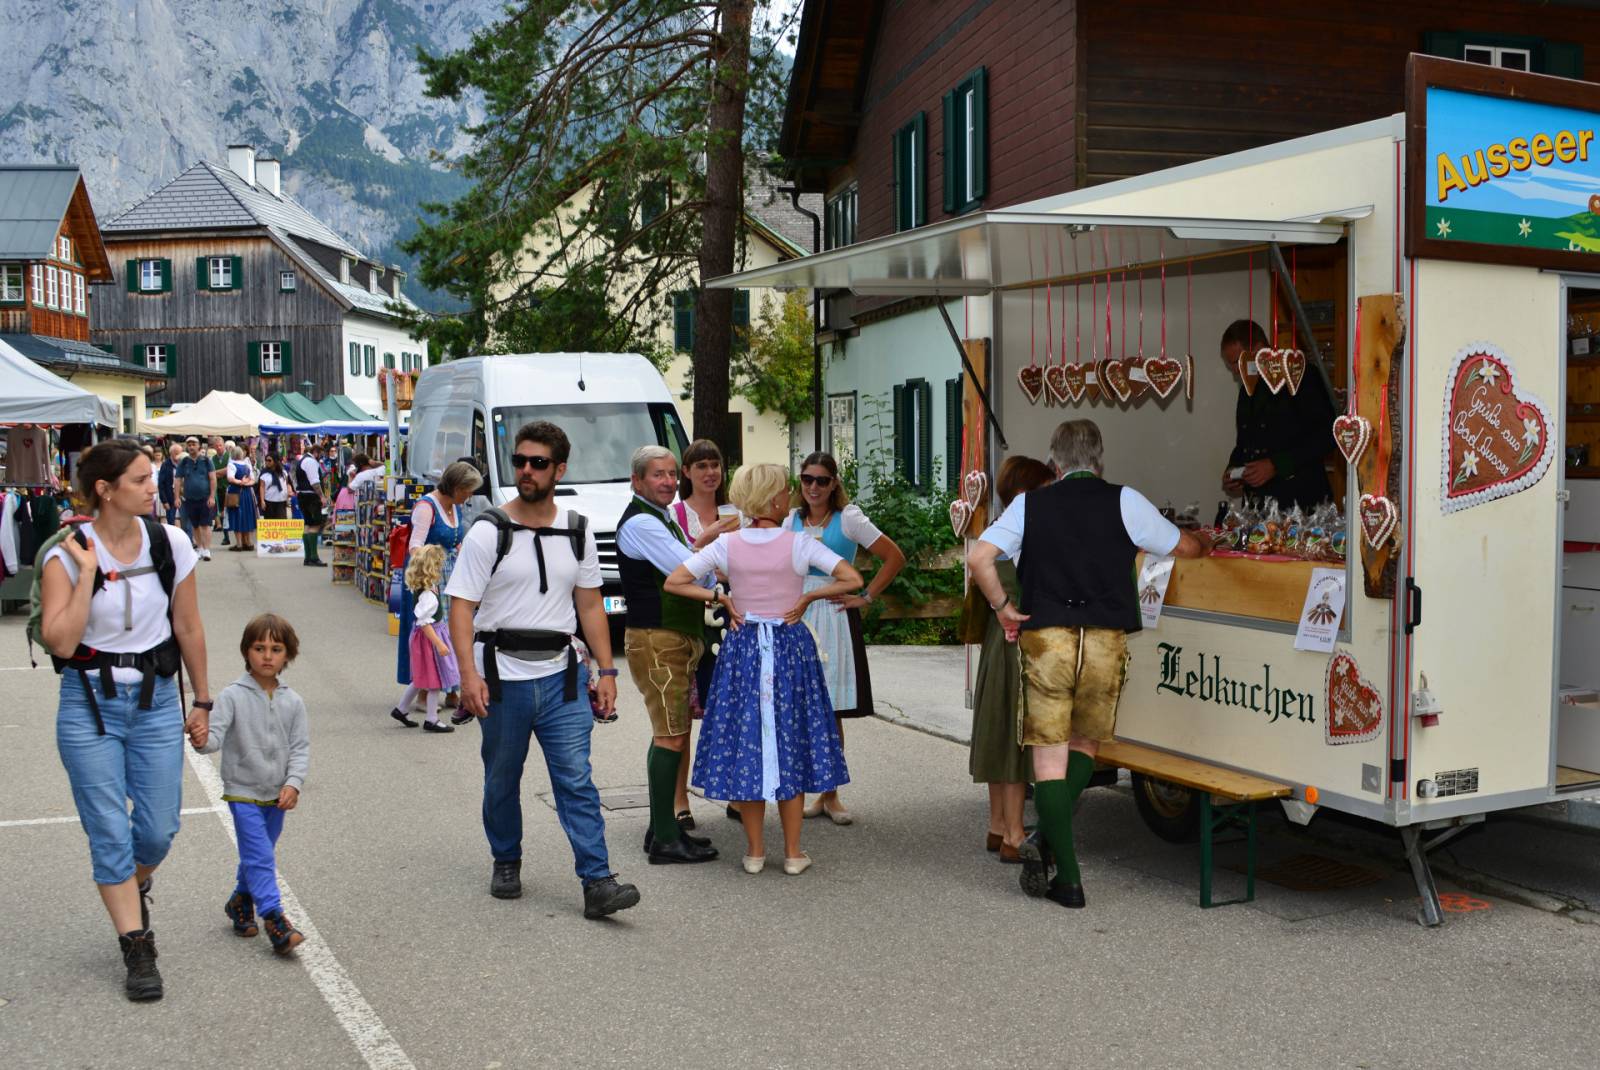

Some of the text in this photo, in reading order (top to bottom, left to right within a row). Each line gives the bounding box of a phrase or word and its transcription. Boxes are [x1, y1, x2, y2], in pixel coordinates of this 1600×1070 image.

[1436, 129, 1594, 203] Ausseer
[1453, 411, 1484, 449] Bad
[1501, 430, 1520, 451] aus
[1156, 642, 1316, 724] Lebkuchen
